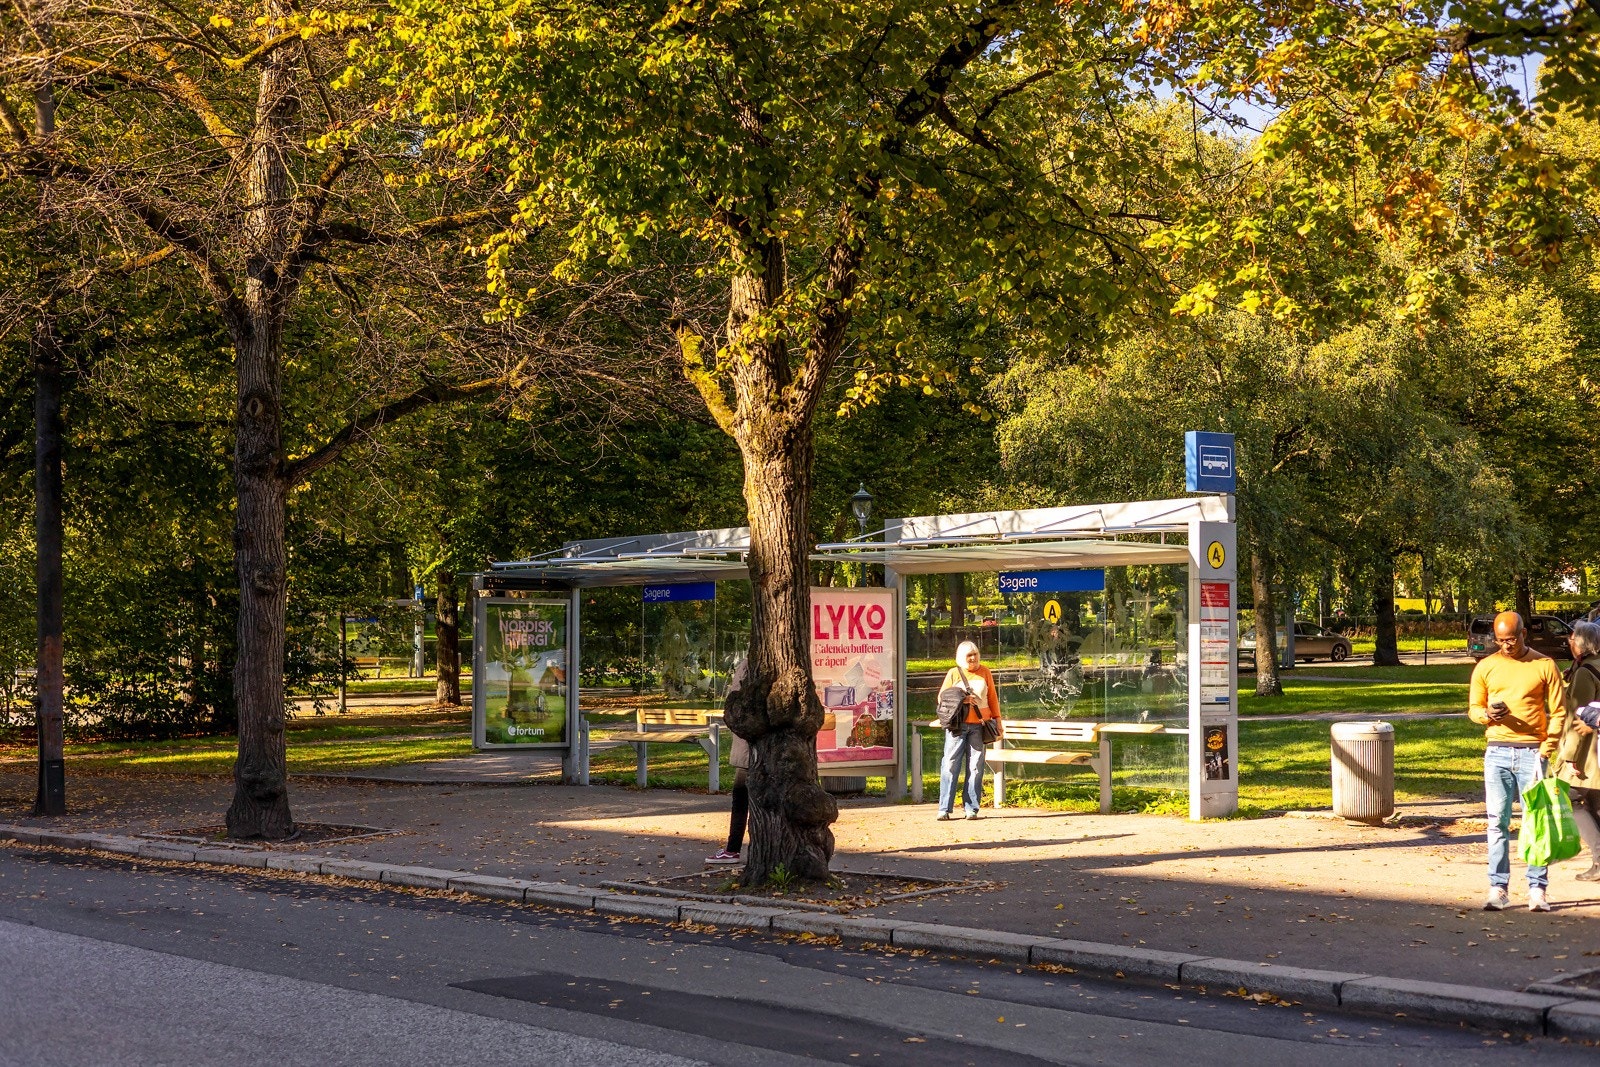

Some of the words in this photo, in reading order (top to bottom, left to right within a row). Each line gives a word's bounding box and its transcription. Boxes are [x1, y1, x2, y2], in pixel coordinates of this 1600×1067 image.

[1000, 575, 1038, 591] Sagene
[644, 588, 671, 601] Sagene
[1048, 604, 1057, 618] A
[499, 620, 554, 633] NORDISK
[814, 604, 886, 640] LYKO
[505, 633, 548, 646] ENERGI
[814, 643, 884, 654] Kalenderbuffeten
[814, 659, 824, 667] er
[825, 656, 847, 668] åpen!
[516, 725, 545, 737] fortum
